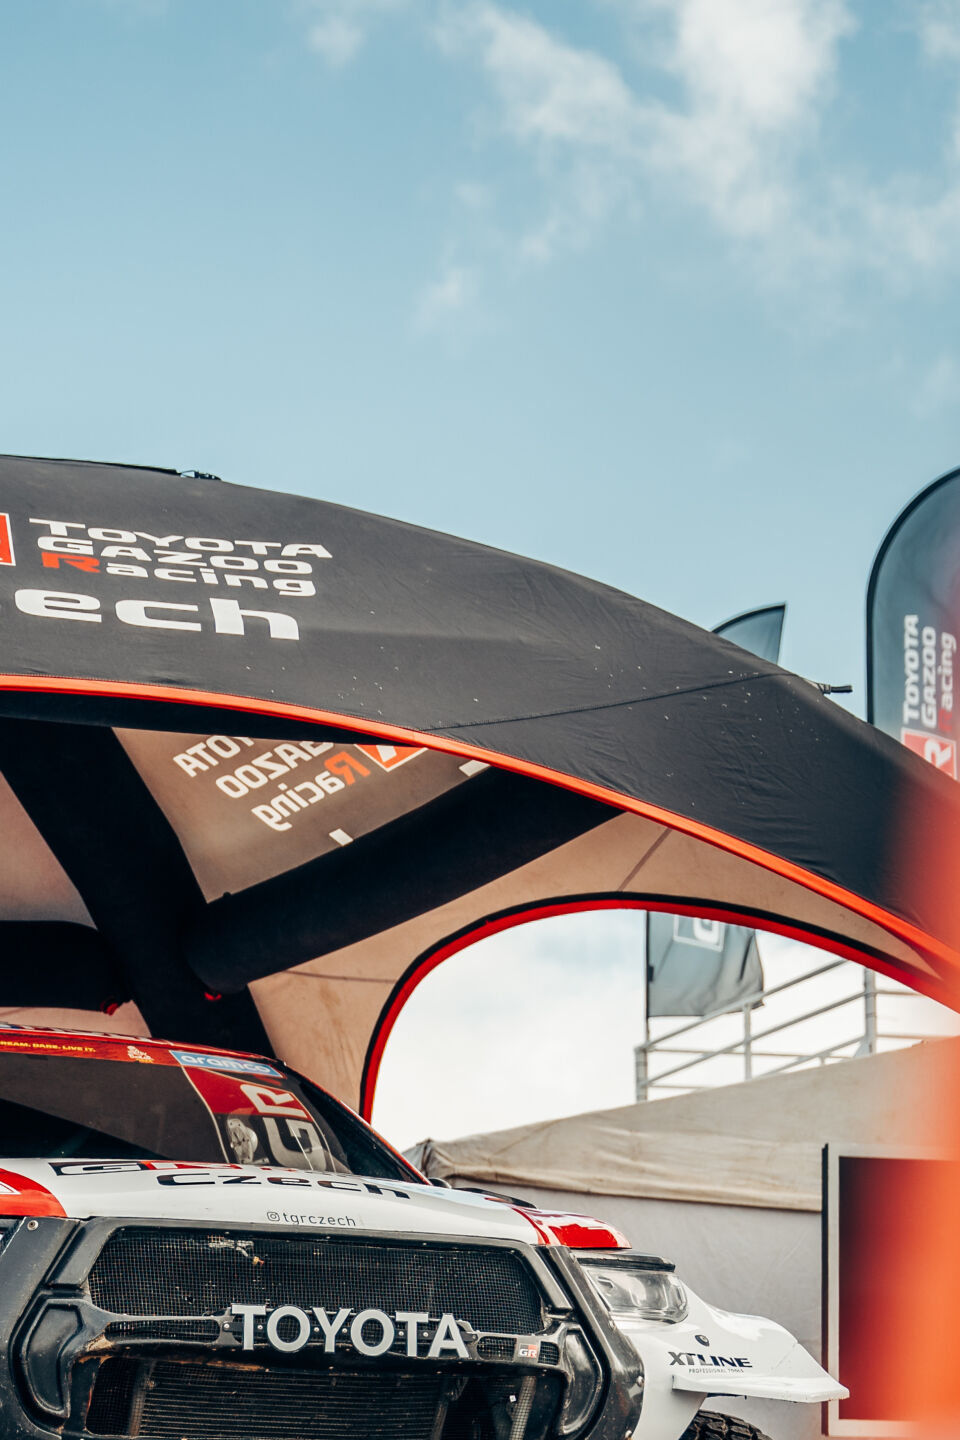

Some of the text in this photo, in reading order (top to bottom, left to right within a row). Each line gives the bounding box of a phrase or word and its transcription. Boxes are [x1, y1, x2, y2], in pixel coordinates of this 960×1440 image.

[29, 517, 333, 558] TOYOTA
[37, 535, 313, 575] GAZOO
[42, 551, 316, 597] Racing
[903, 614, 920, 725] TOYOTA
[921, 626, 937, 729] GAZOO
[180, 1055, 271, 1073] aramco
[231, 1303, 470, 1358] TOYOTA
[519, 1348, 537, 1358] GR
[667, 1351, 753, 1368] XTLINE
